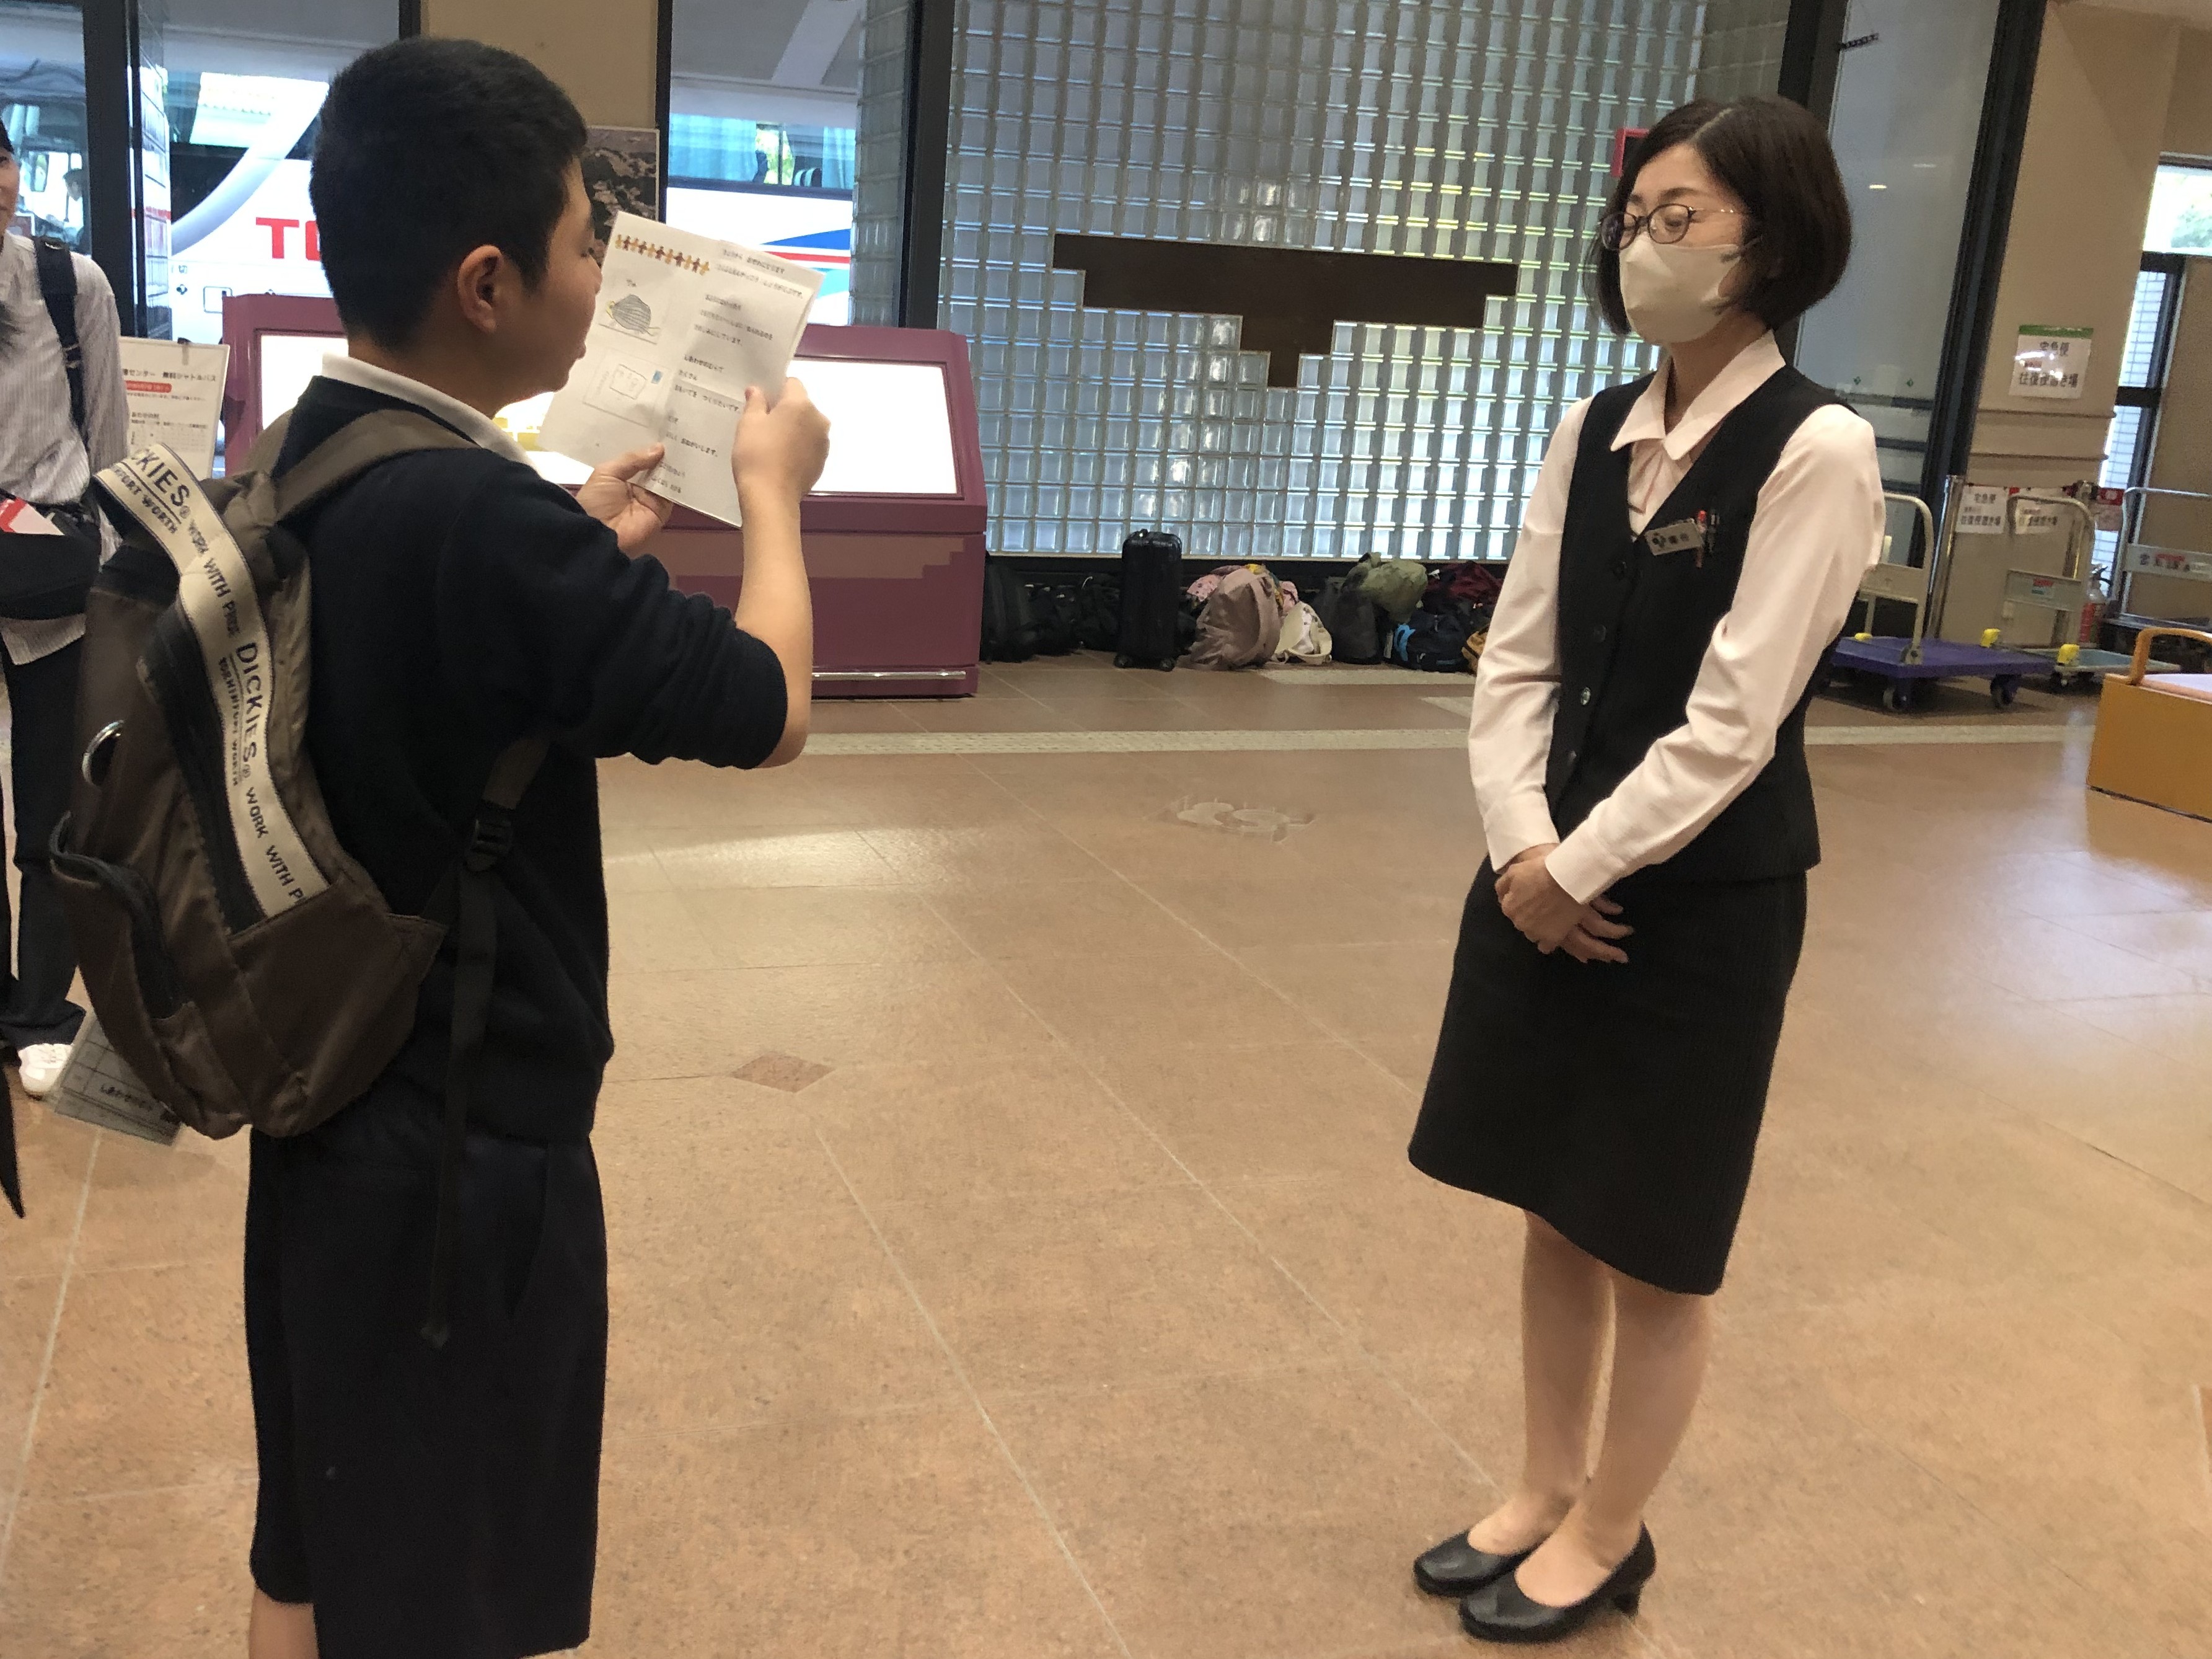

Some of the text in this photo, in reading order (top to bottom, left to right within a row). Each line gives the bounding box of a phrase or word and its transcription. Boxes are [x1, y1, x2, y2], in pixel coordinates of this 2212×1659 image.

[203, 557, 231, 598] WITH
[245, 786, 269, 839] WORK
[265, 844, 295, 887] WITH
